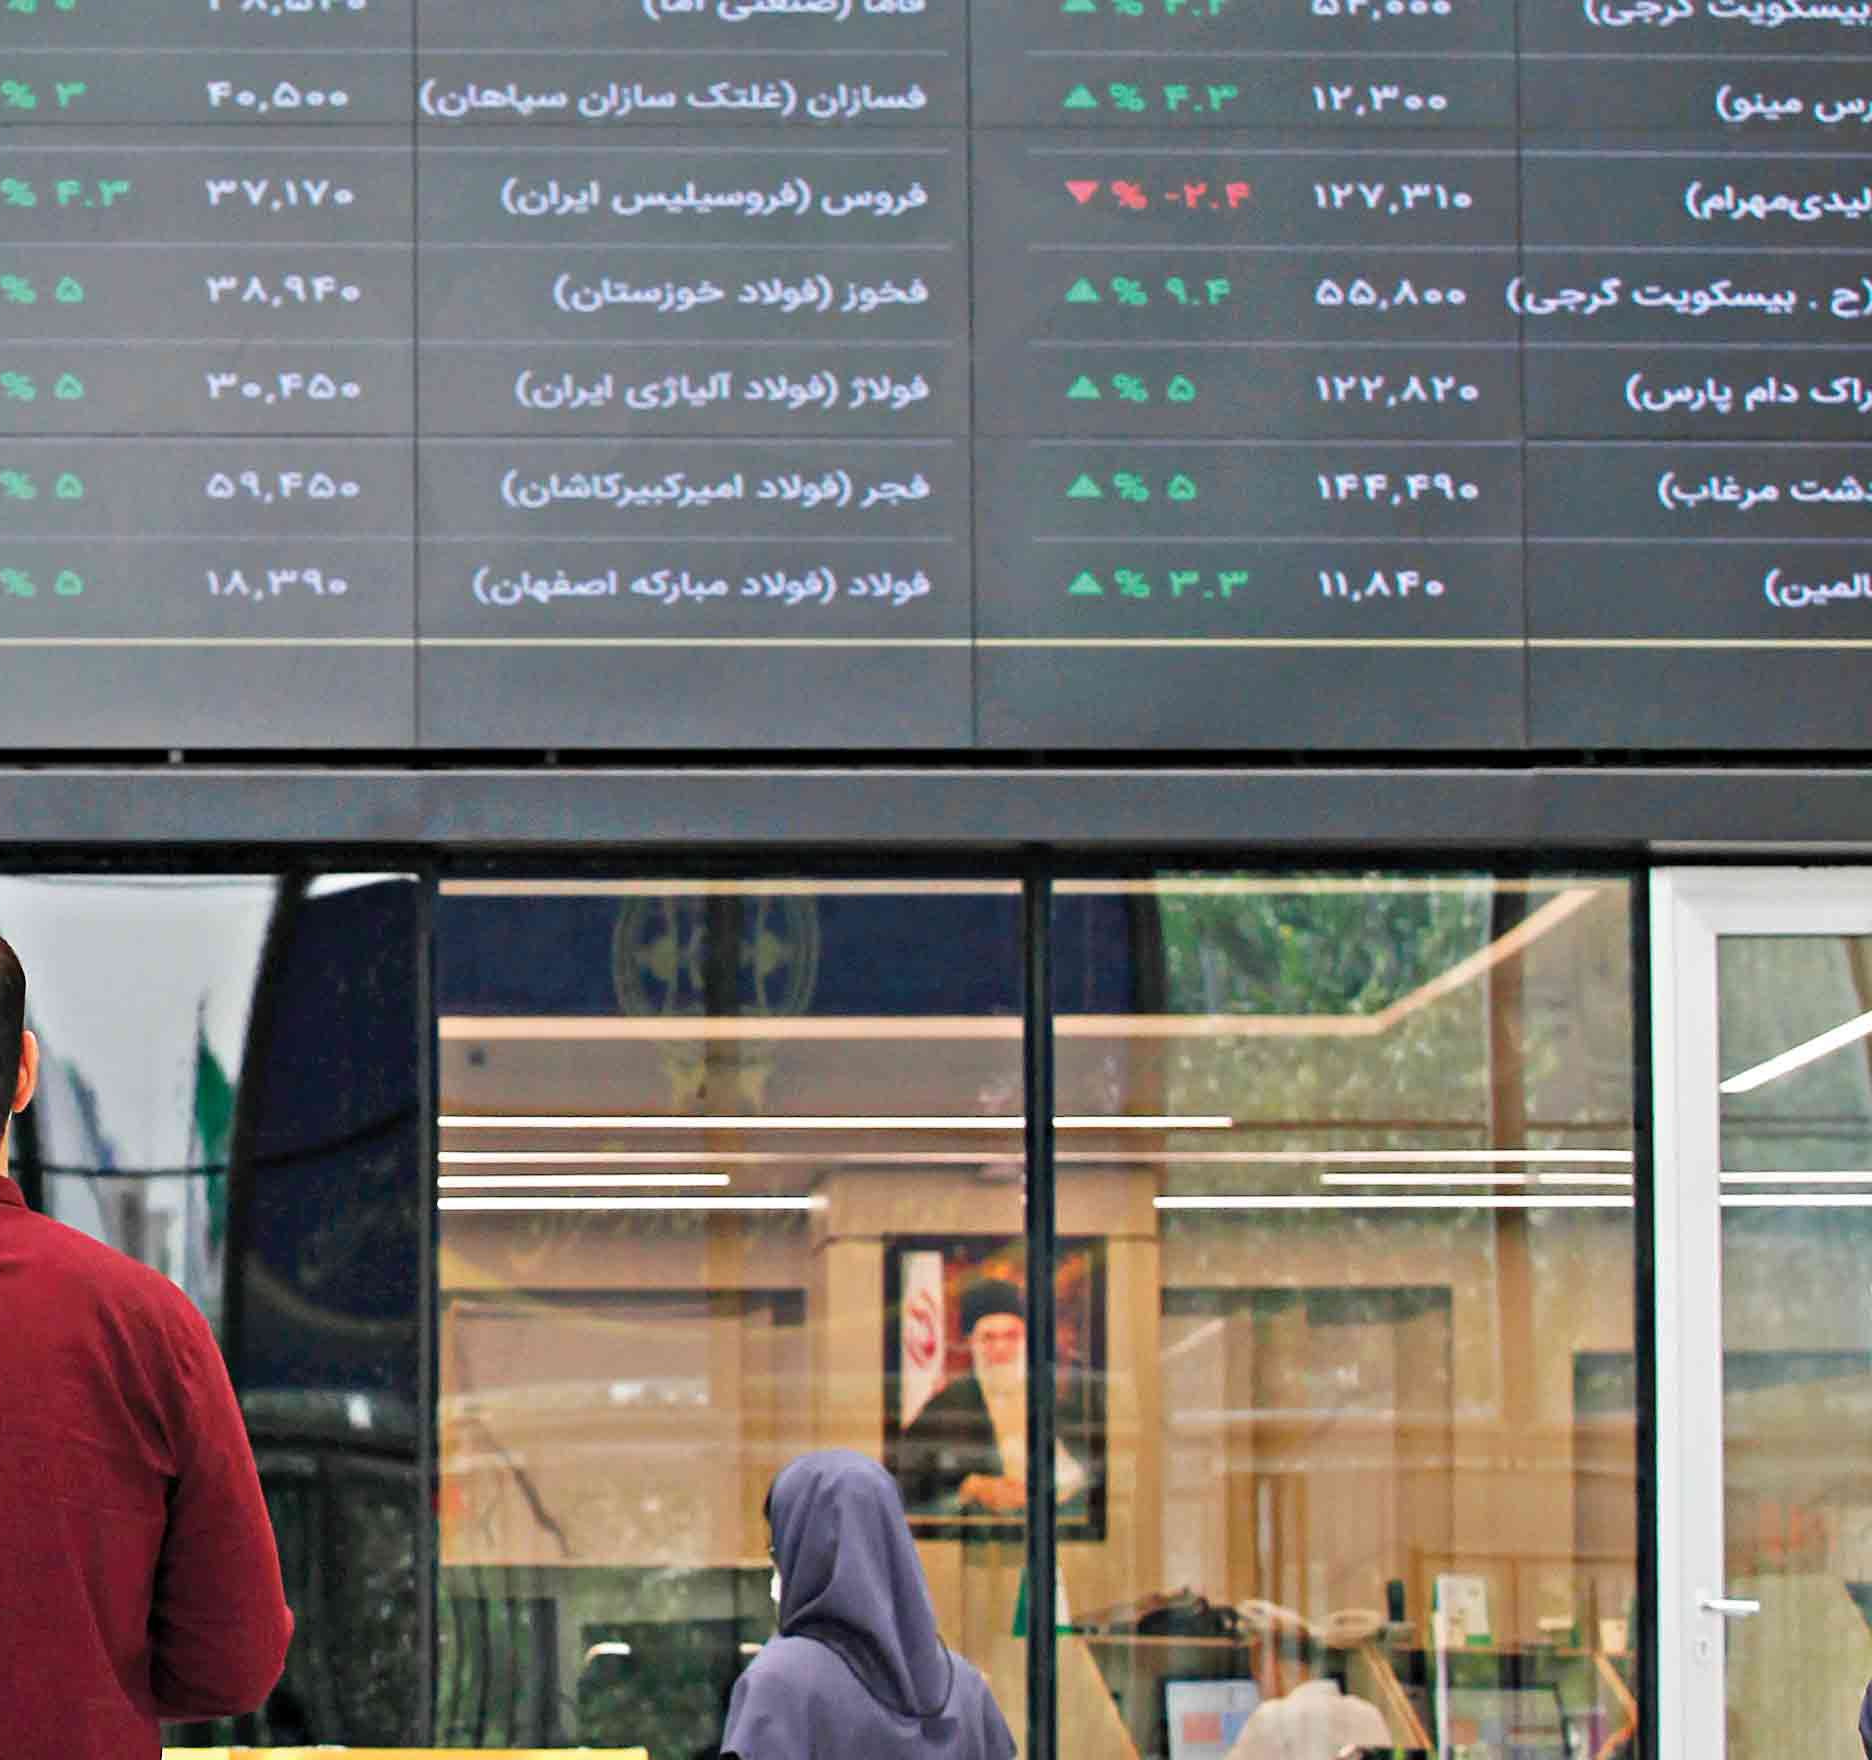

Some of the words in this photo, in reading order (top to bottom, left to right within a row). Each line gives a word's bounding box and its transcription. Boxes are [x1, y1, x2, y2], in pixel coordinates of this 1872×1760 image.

[55, 79, 88, 112] ۳
[417, 78, 569, 117] سپاهان)
[576, 79, 677, 119] سازان
[687, 79, 797, 117] (غلتک
[803, 79, 927, 120] فسازان
[1714, 83, 1804, 123] مینو)
[498, 175, 600, 216] ایران)
[611, 175, 812, 216] (فروسیلیس
[818, 180, 929, 217] فروس
[54, 276, 84, 306] ۵
[551, 271, 725, 313] خوزستان)
[738, 271, 833, 313] (فولاد
[838, 278, 929, 313] فخوز
[1503, 276, 1622, 316] گرجی)
[1630, 278, 1798, 317] بیسکویت
[54, 371, 84, 398] ۵
[516, 367, 613, 409] ایران)
[623, 367, 732, 409] آلیاژی
[743, 370, 839, 409] (فولاد
[847, 371, 930, 409] فولاژ
[1166, 373, 1197, 403] ۵
[1623, 372, 1733, 415] پارس)
[1743, 375, 1800, 412] دام
[54, 470, 84, 498] ۵
[501, 469, 744, 508] امیرکبیرکاشان)
[757, 470, 853, 510] (فولاد
[859, 474, 931, 508] فجر
[1166, 471, 1199, 503] ۵
[1656, 471, 1780, 511] مرغاب)
[54, 567, 84, 598] ۵
[471, 567, 617, 605] اصفهان)
[628, 567, 729, 605] مبارکه
[741, 563, 837, 605] (فولاد
[846, 574, 931, 606] فولاد
